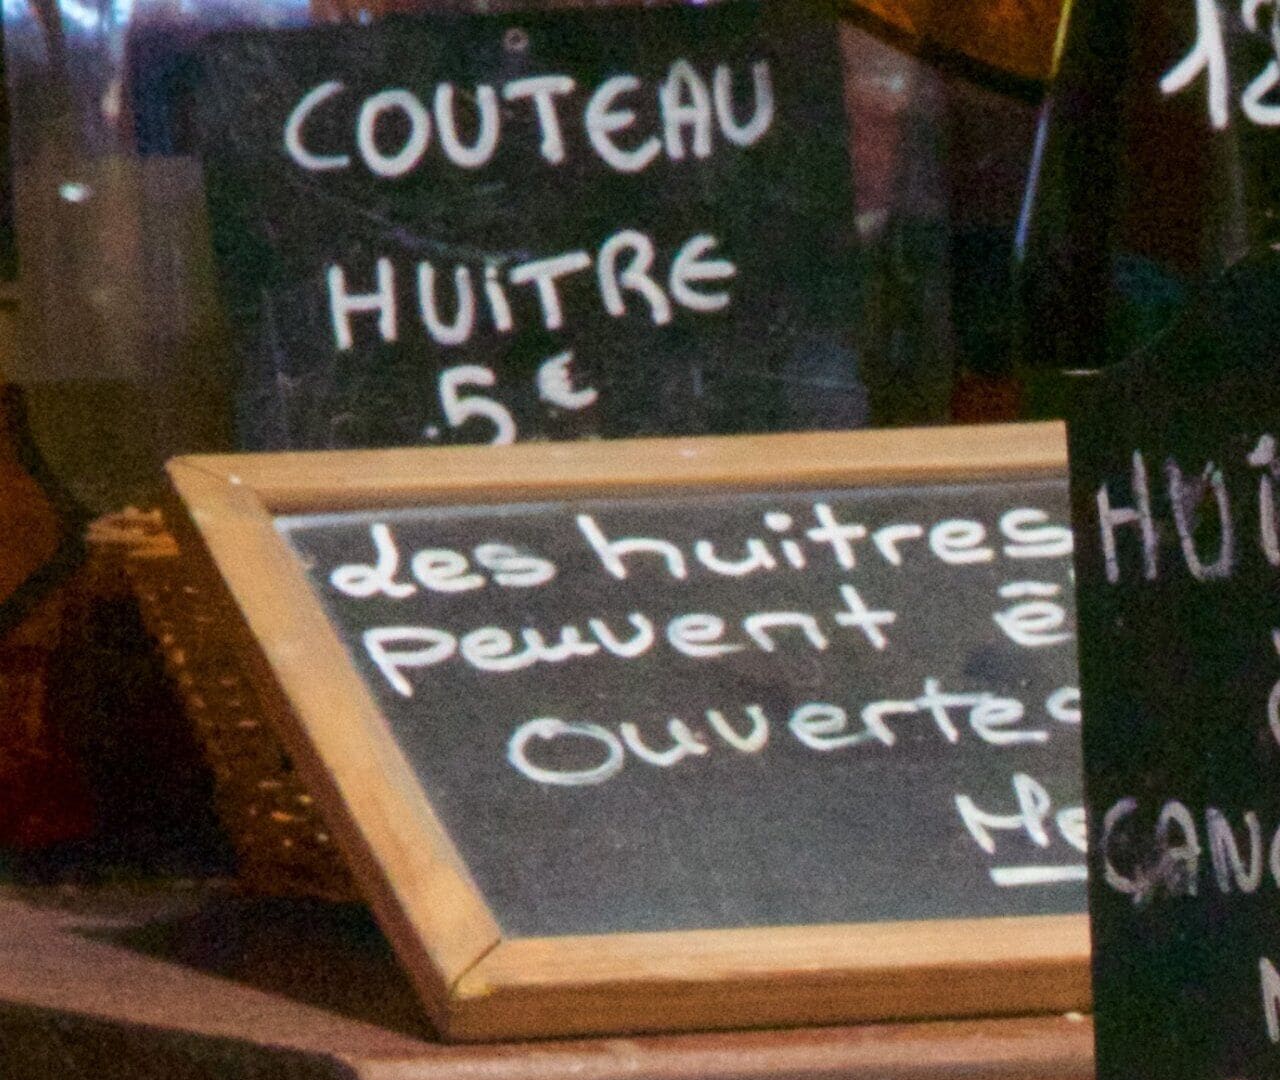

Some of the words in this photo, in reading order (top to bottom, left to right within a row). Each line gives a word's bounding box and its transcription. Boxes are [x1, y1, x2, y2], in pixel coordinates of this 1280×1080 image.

[285, 58, 775, 177] COUTEAU
[577, 502, 1073, 580] huitres
[362, 585, 896, 697] peuvent
